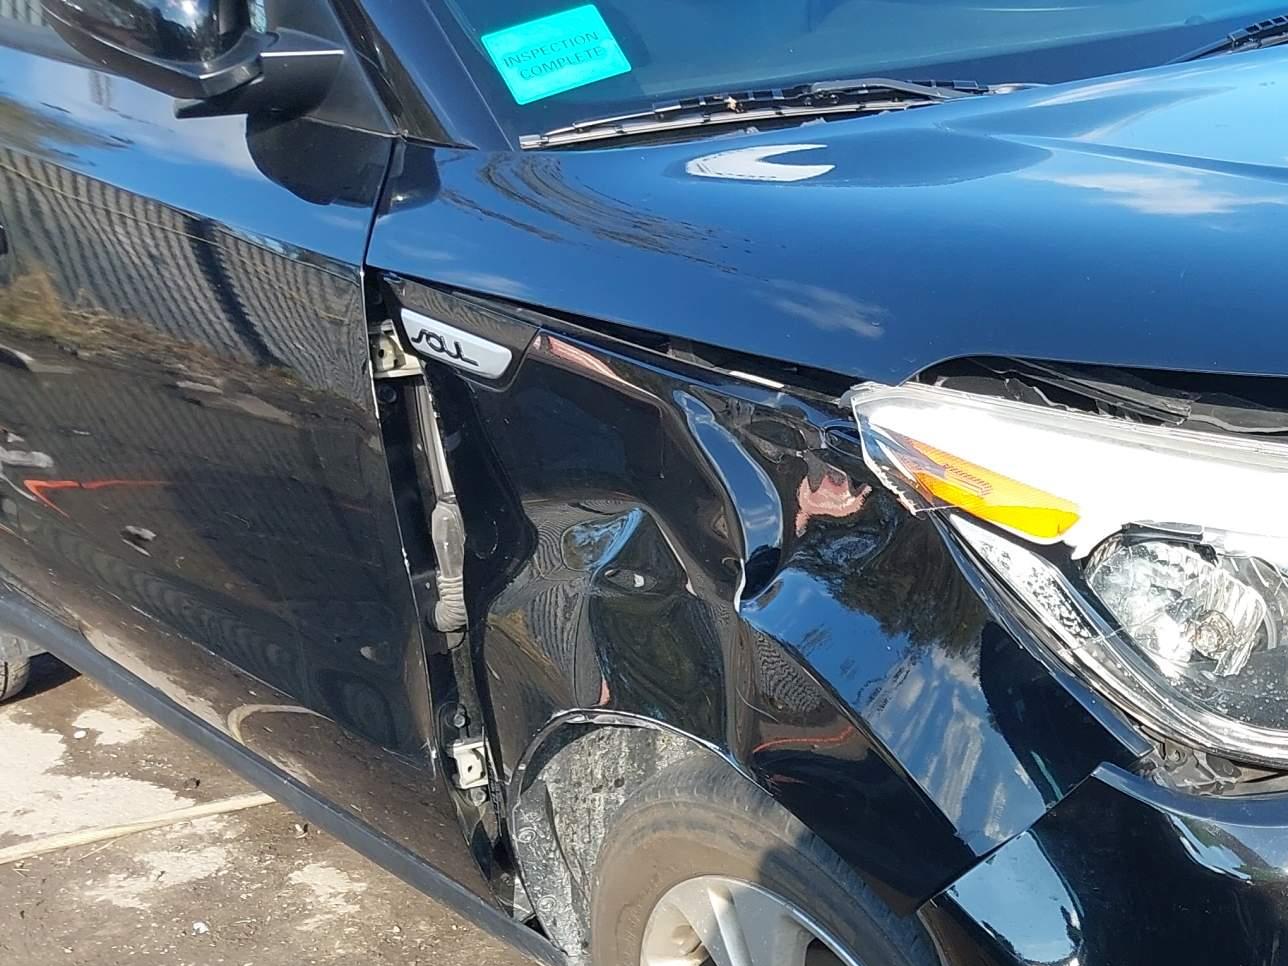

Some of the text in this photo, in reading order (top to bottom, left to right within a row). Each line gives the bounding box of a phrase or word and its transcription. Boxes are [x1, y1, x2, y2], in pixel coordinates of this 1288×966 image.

[502, 32, 598, 68] INSPECTION
[519, 47, 602, 80] COMPLETE
[411, 329, 480, 367] SOUL
